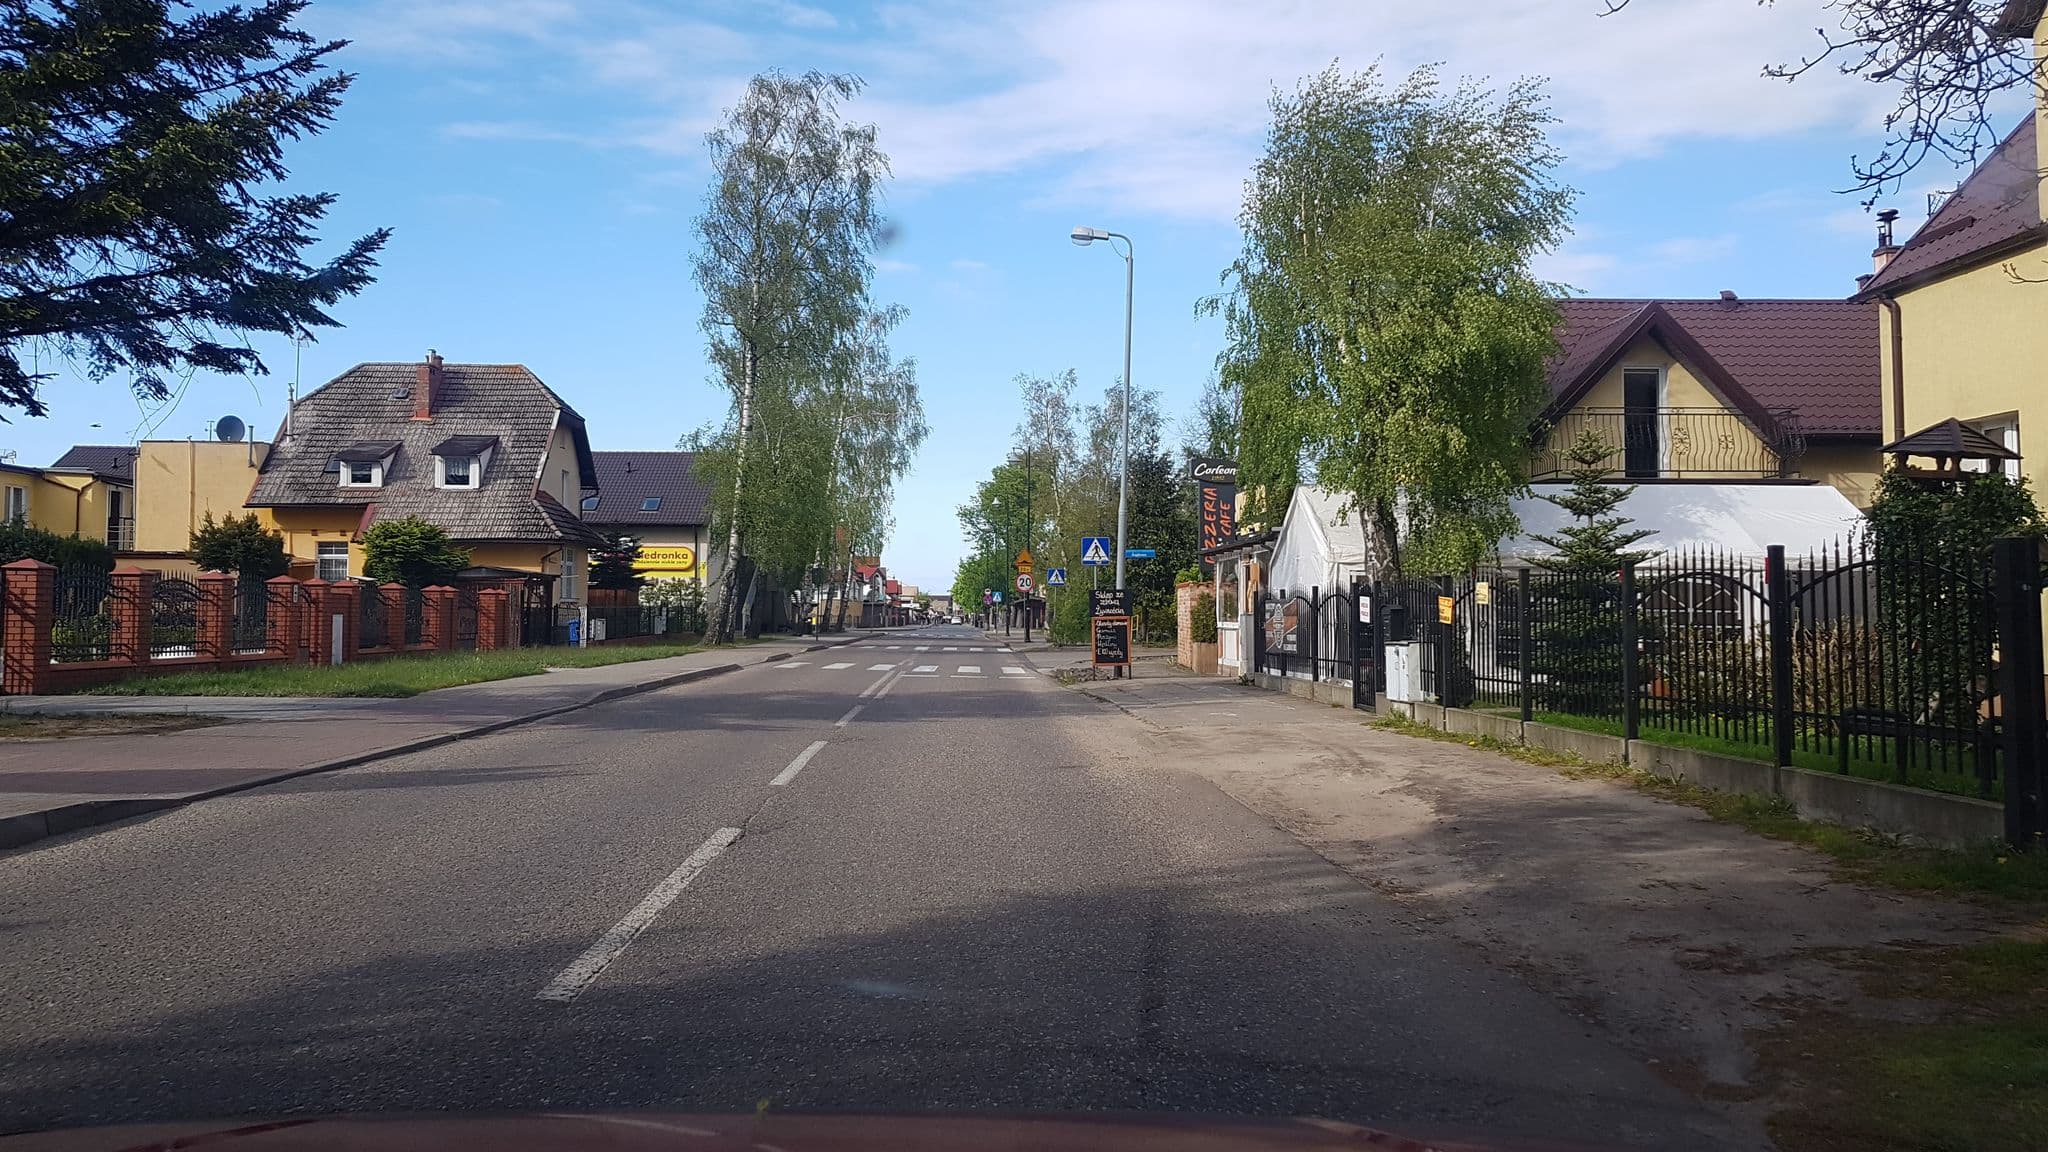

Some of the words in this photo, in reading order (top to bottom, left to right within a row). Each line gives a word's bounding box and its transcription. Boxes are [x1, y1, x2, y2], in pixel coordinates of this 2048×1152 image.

[1194, 462, 1237, 476] Corleon
[1219, 499, 1232, 536] CAFE
[1203, 487, 1218, 565] PZZERIA
[640, 551, 688, 559] iedronka
[1020, 578, 1031, 587] 20
[1095, 591, 1113, 599] Sklep
